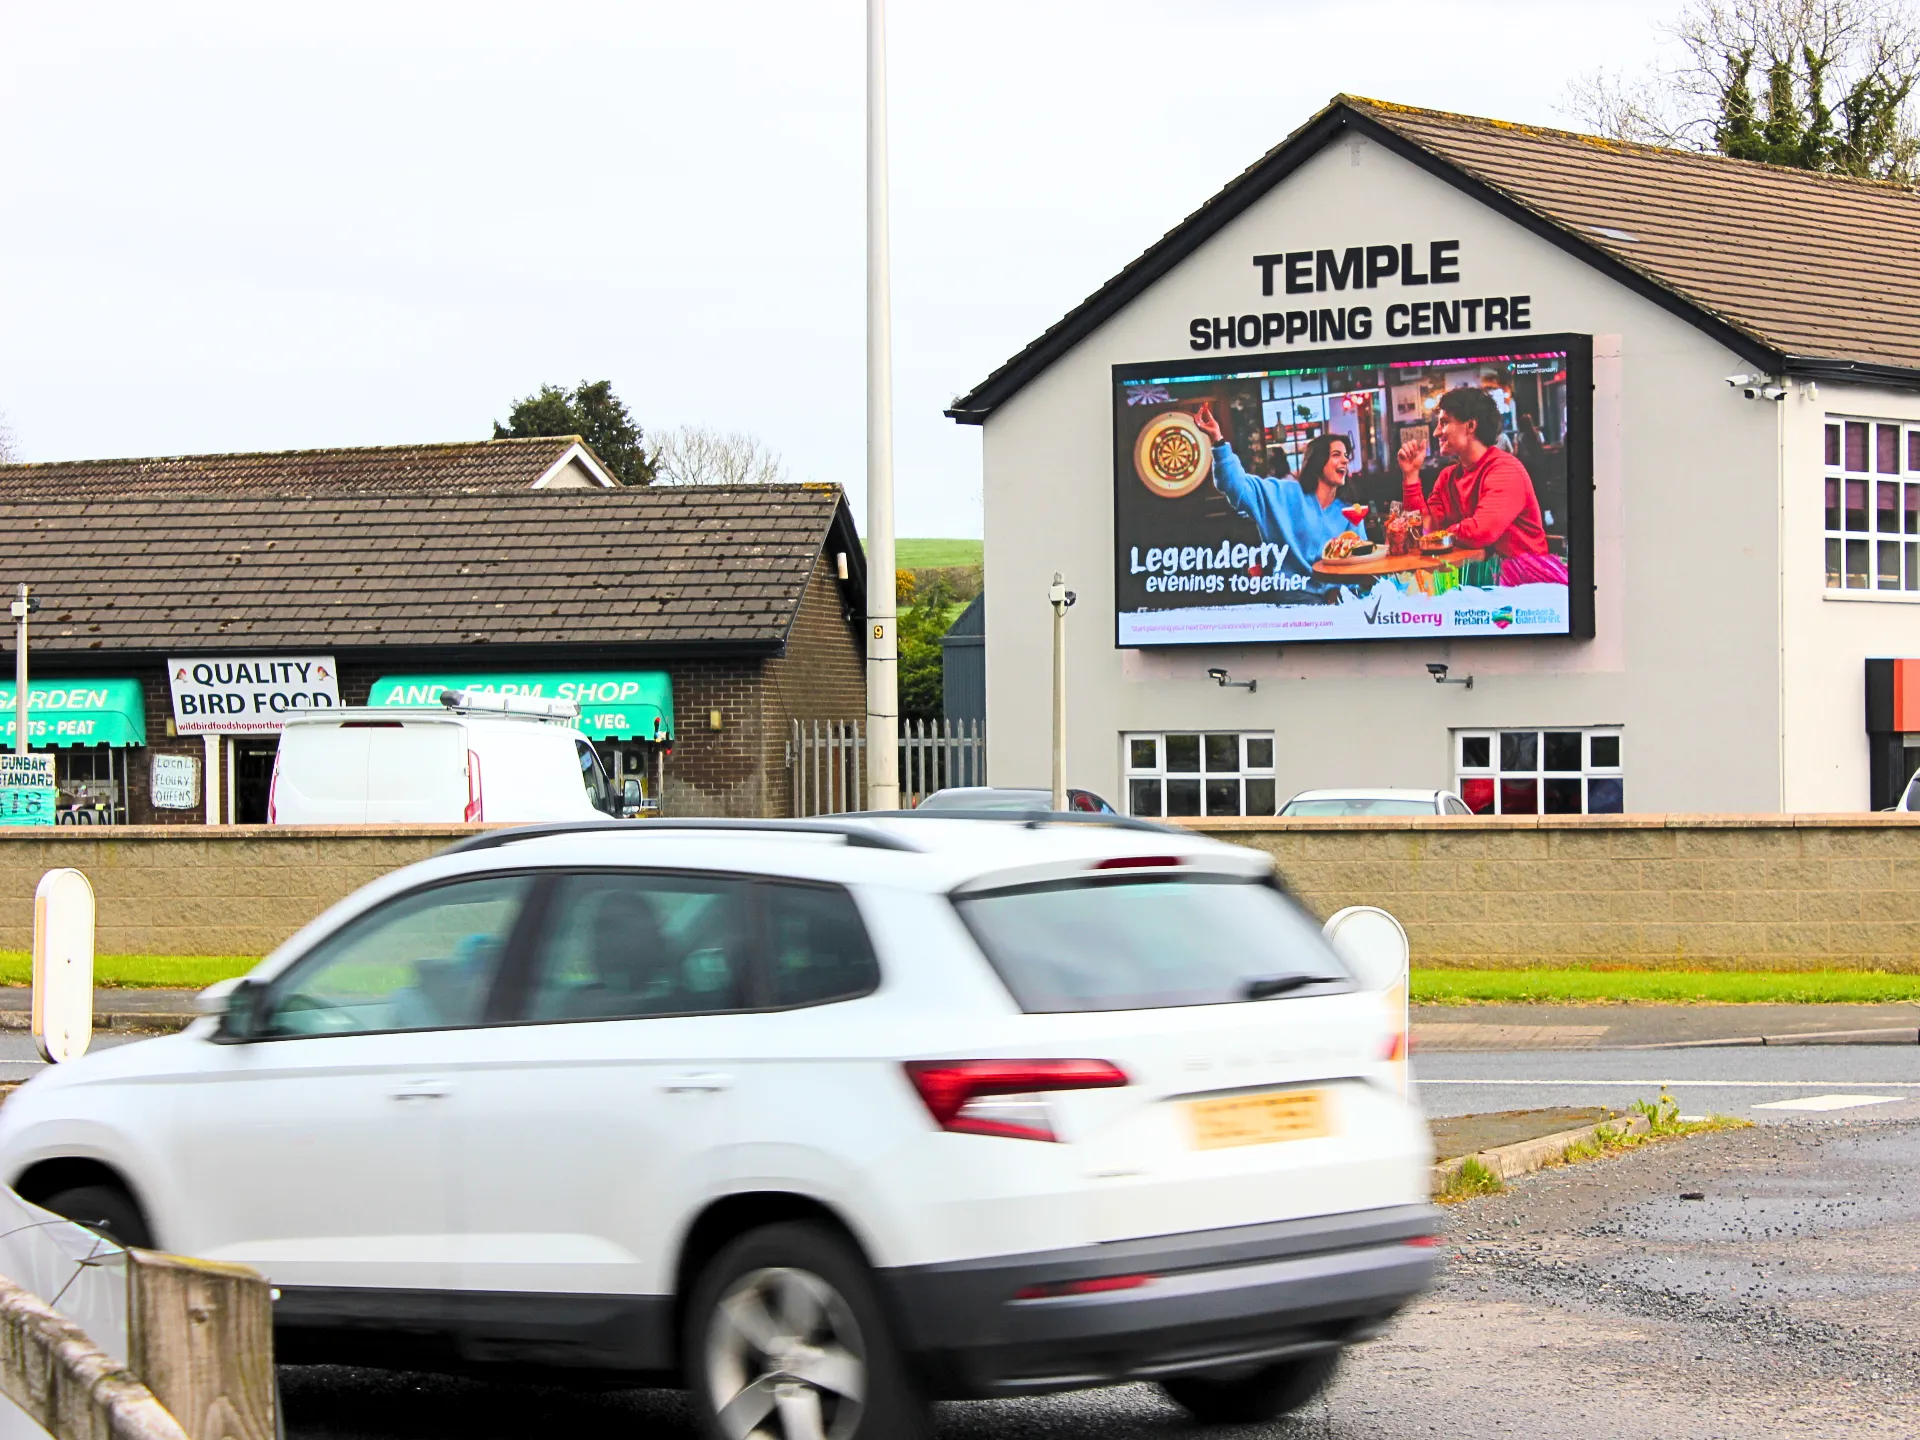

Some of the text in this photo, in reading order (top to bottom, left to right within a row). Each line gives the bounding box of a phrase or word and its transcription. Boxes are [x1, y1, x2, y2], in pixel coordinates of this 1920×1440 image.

[1252, 239, 1460, 296] TEMPLE
[1189, 295, 1531, 351] SHOPPING CENTRE
[1130, 540, 1289, 574] Legenderry
[1145, 572, 1311, 595] evenings together
[1363, 595, 1443, 627] VisitDerry
[1454, 608, 1490, 617] Northern
[1454, 616, 1490, 626] Ireland
[875, 626, 883, 638] 9
[1289, 620, 1334, 629] visitderry.com
[192, 662, 312, 687] QUALITY
[180, 691, 333, 715] BIRD FOOD
[385, 684, 448, 705] AND
[555, 682, 640, 702] SHOP
[6, 720, 96, 737] PTS PEAT
[178, 720, 285, 732] wildbirdfoodshopnorther
[1, 756, 47, 771] DUNBAR
